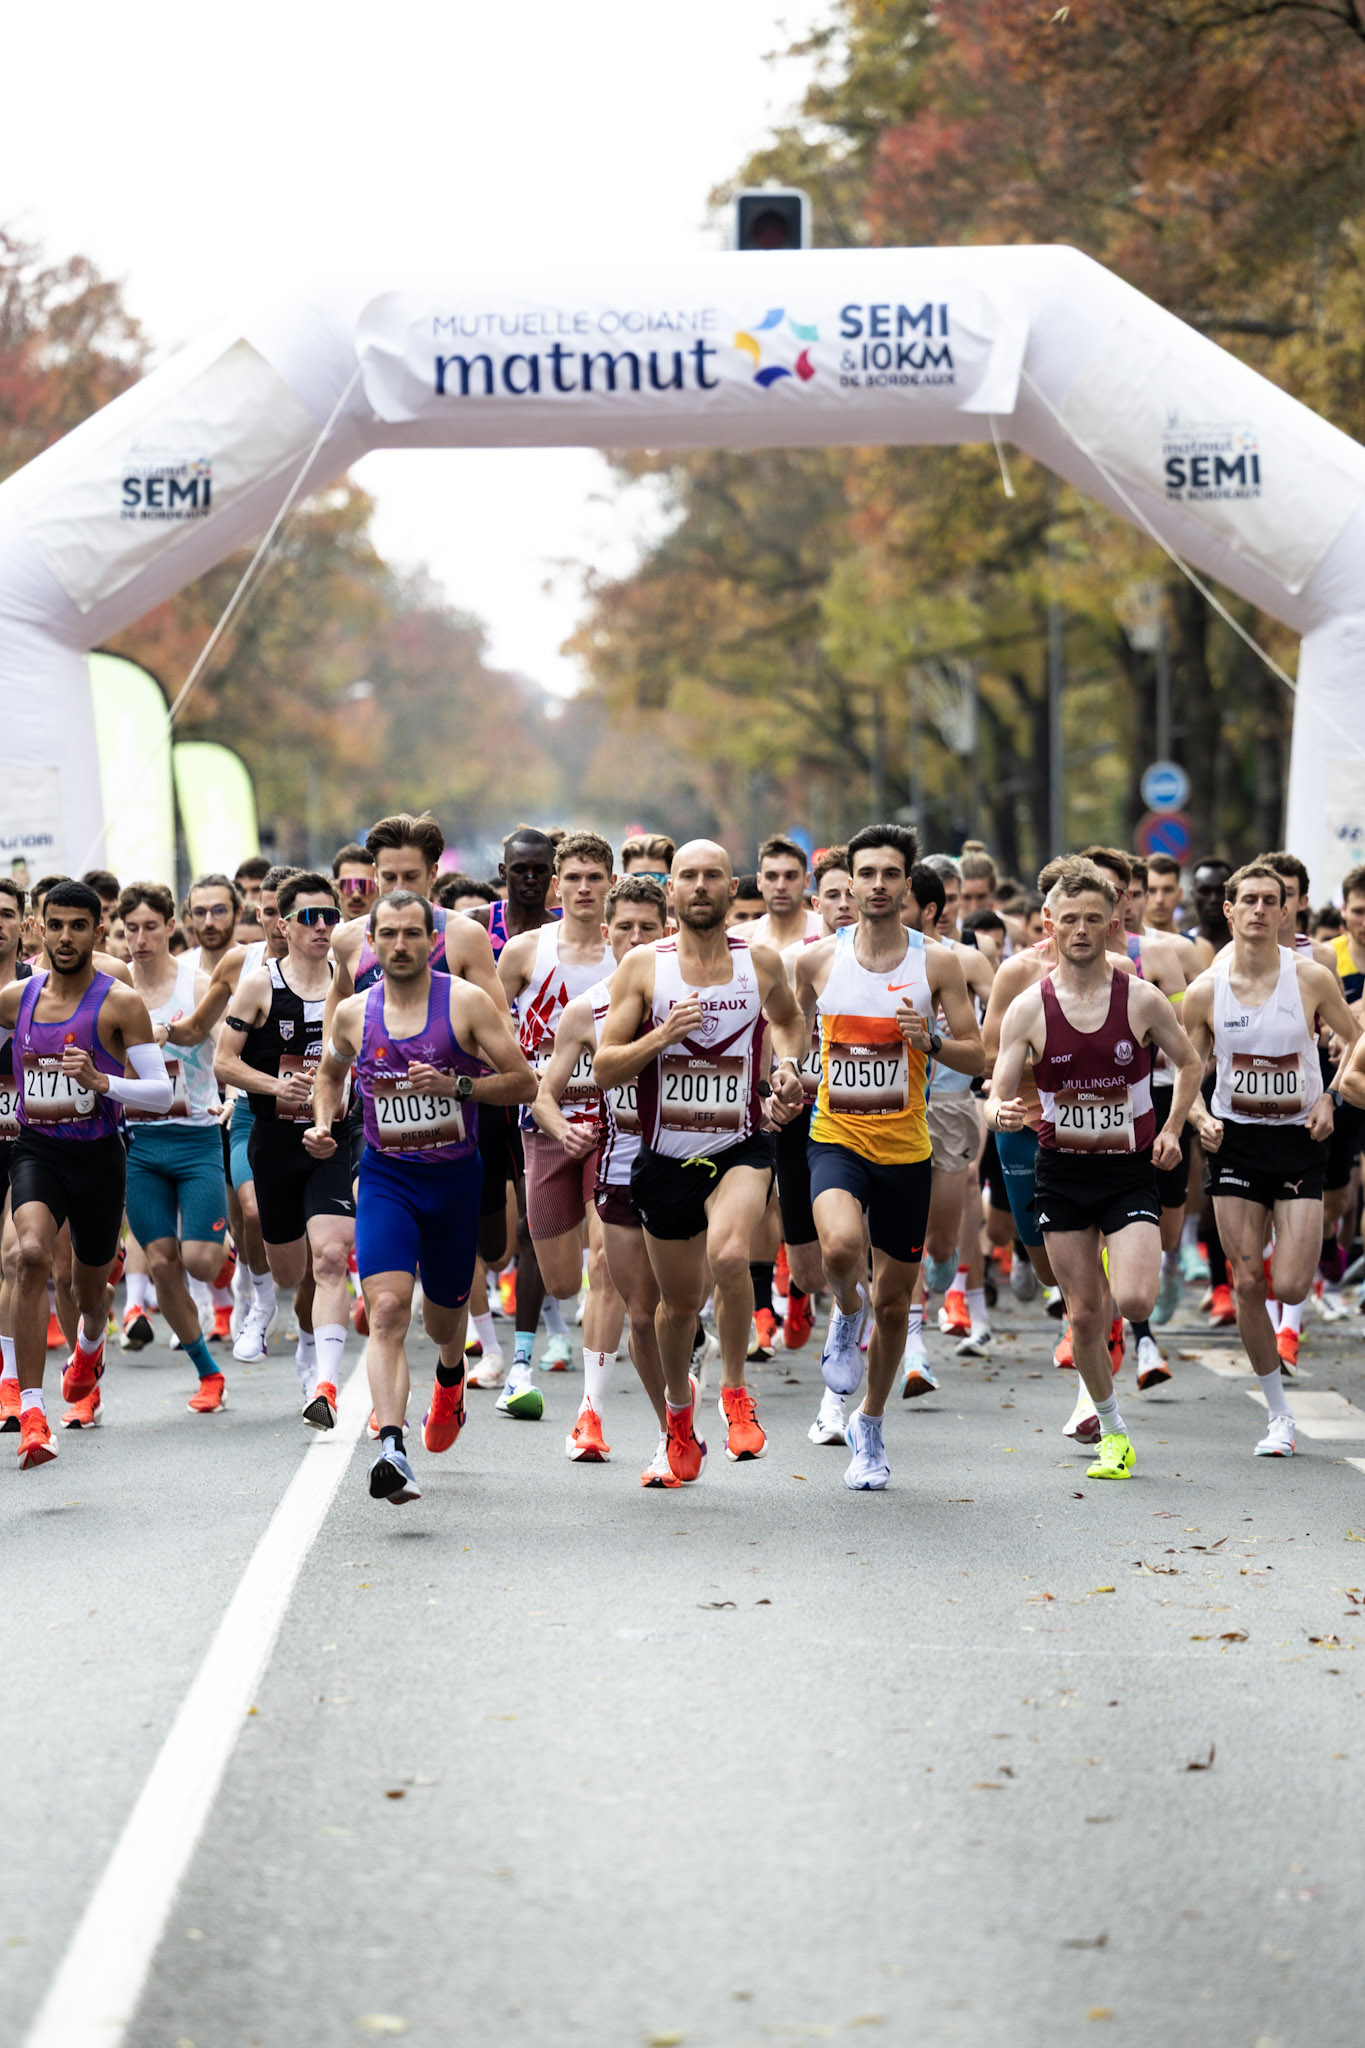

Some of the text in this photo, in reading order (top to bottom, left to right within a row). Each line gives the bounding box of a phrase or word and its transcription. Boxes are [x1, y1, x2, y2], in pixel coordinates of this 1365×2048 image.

[433, 308, 716, 337] MUTUELLE OCIANE
[840, 303, 949, 338] SEMI
[434, 339, 719, 396] matmut
[840, 374, 955, 386] DE BORDEAUX
[1165, 453, 1260, 488] SEMI
[122, 477, 211, 507] SEMI
[668, 999, 748, 1012] DEAUX
[304, 1045, 322, 1057] HB
[1050, 1054, 1073, 1064] soar
[832, 1059, 899, 1087] 20507
[1062, 1075, 1126, 1090] MULLINGAR
[1234, 1070, 1297, 1095] 20100
[563, 1085, 600, 1095] NTHONY
[666, 1073, 738, 1103] 20018
[378, 1094, 451, 1124] 20035
[693, 1112, 717, 1122] JEFF
[1058, 1103, 1125, 1130] 20135
[401, 1128, 442, 1141] PIERRIK
